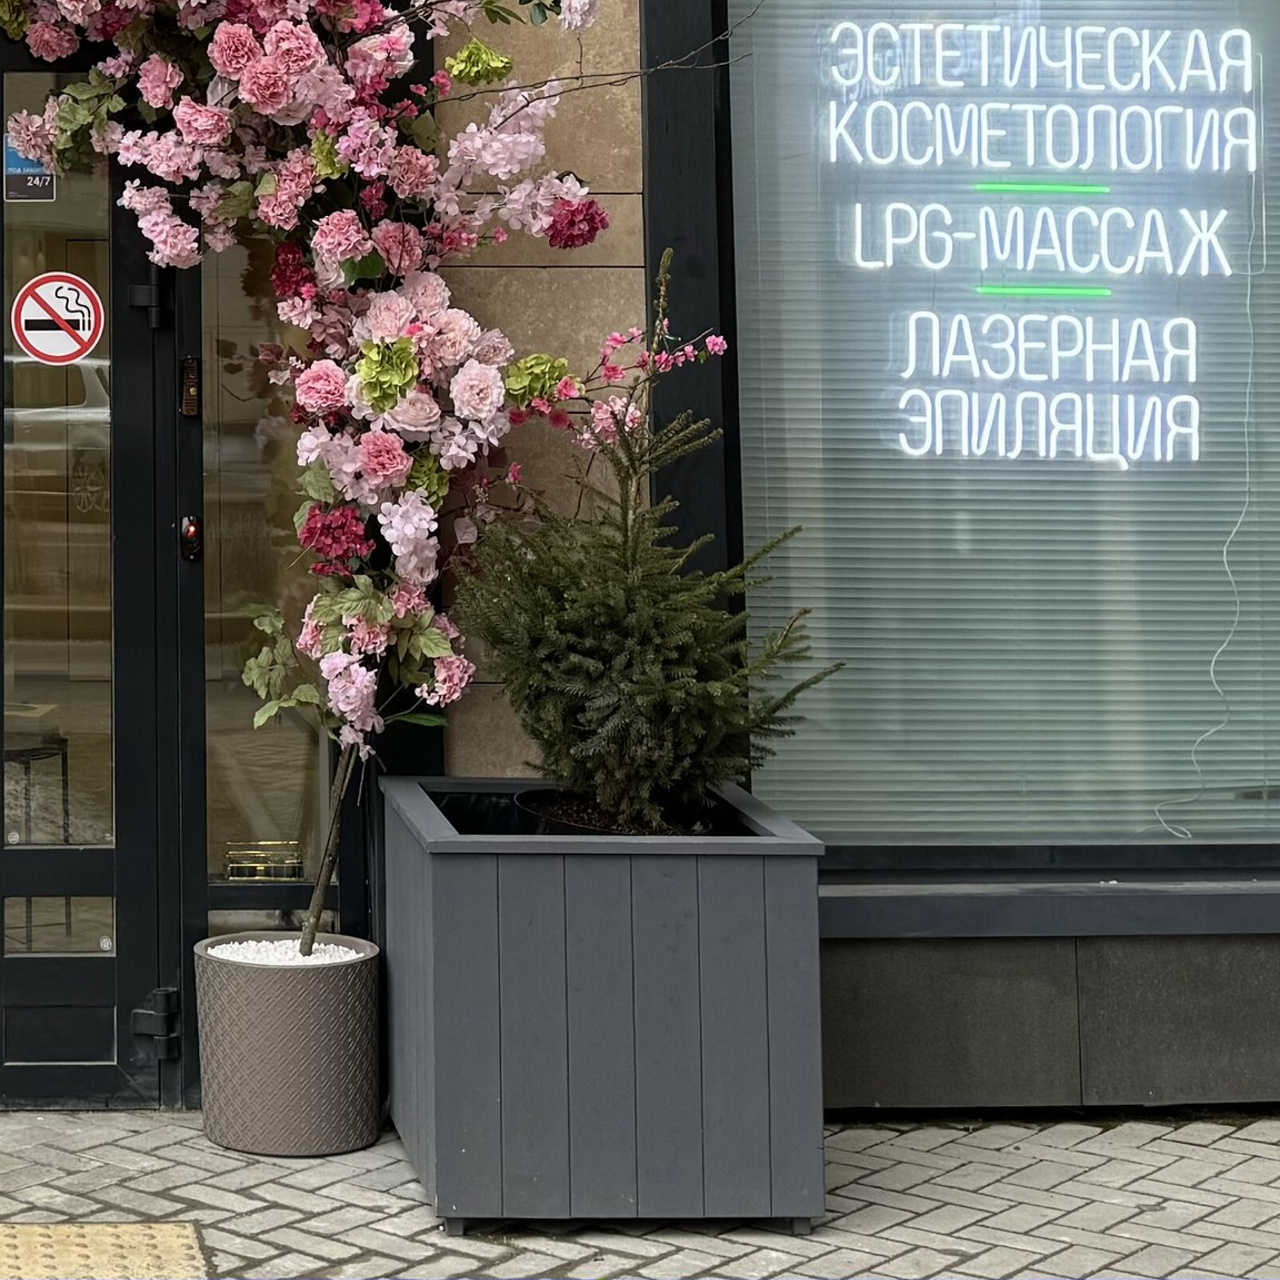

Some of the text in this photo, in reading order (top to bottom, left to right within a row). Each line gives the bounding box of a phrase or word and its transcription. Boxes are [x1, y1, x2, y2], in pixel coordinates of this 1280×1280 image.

[829, 21, 1253, 93] ЭСТЕТИЧЕСКАЯ
[828, 100, 1257, 172] КОСМЕТОЛОГИЯ
[27, 176, 51, 187] 24/7
[855, 202, 1232, 276] LPG-МАССАЖ
[900, 311, 1198, 383] ЛАЗЕРНАЯ
[898, 389, 1200, 471] ЭПИЛЯЦИЯ
